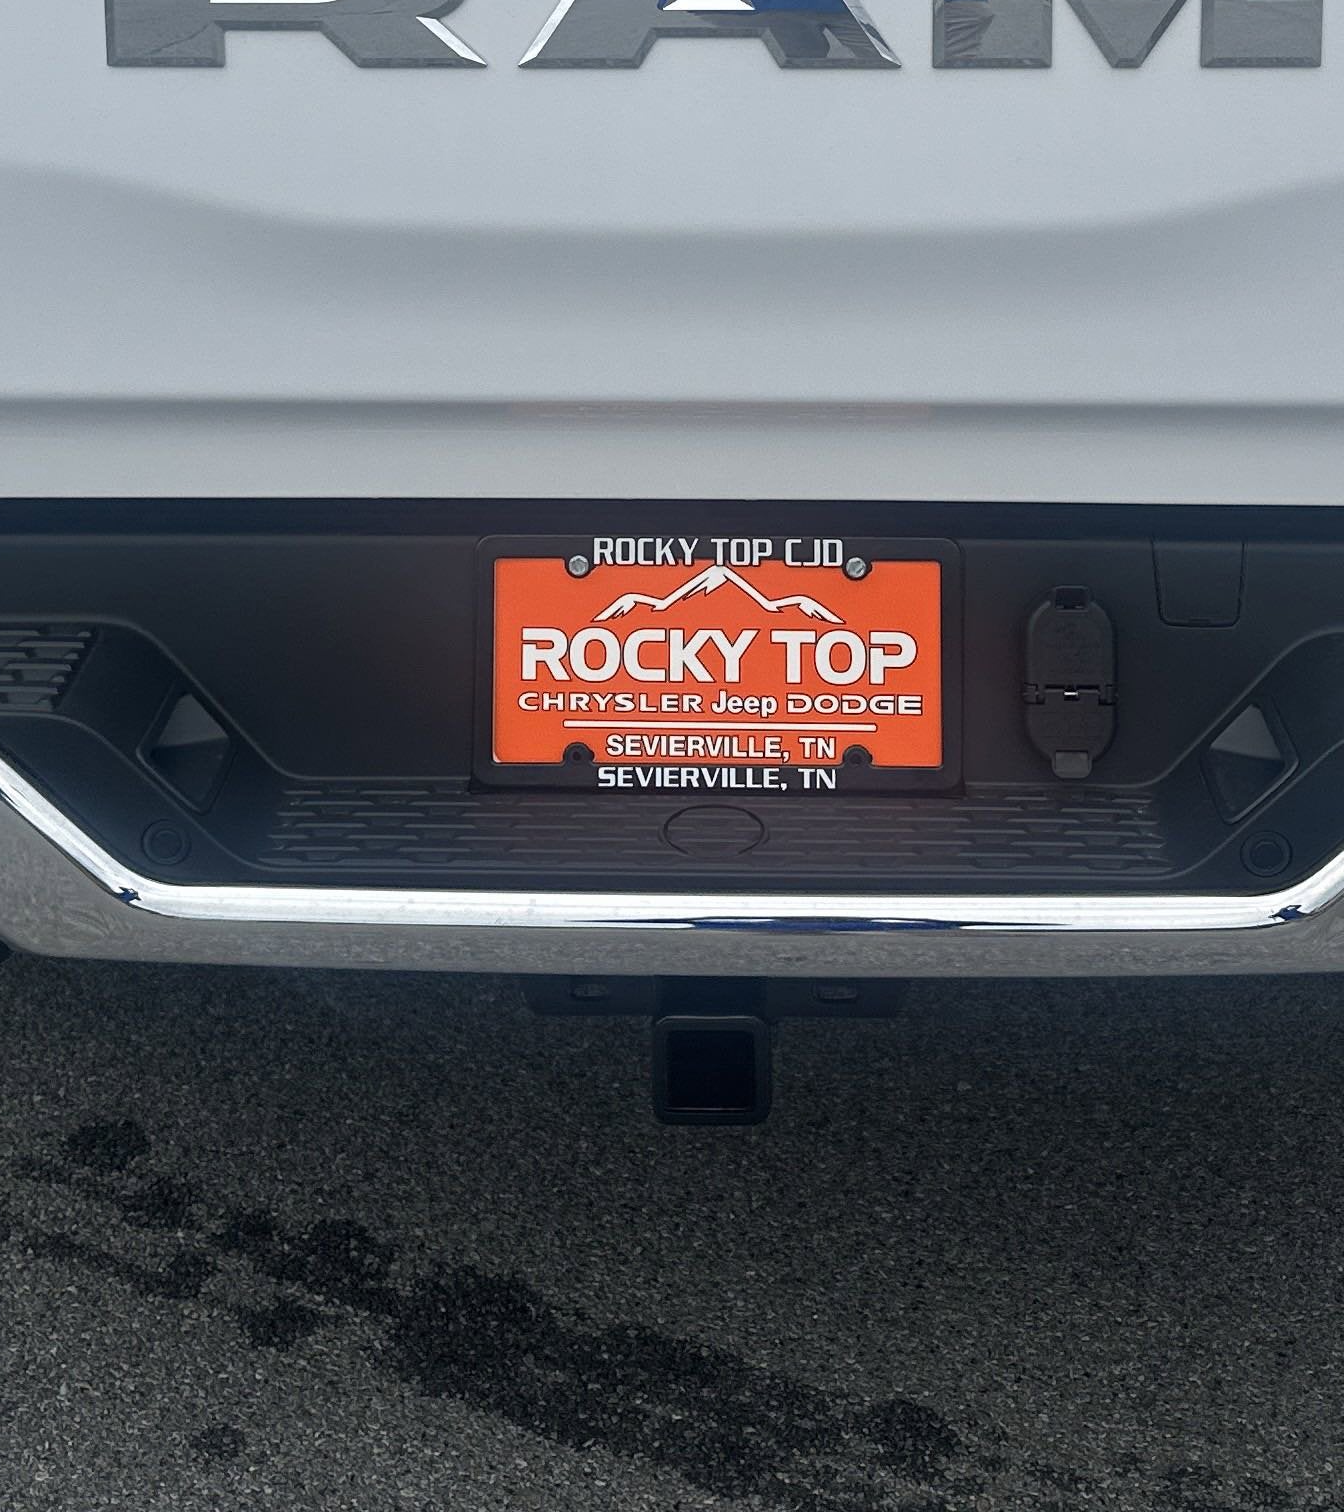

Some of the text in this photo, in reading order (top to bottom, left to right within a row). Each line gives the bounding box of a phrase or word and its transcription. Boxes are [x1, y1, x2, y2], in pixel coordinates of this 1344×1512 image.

[592, 537, 844, 568] ROCKY TOP CJD
[520, 627, 919, 686] ROCKY TOP
[517, 690, 923, 718] CHRYSLER Jeep DODGE
[605, 734, 836, 763] SEVIERVILLE, TN
[597, 766, 837, 791] SEVIERVILLE, TN
